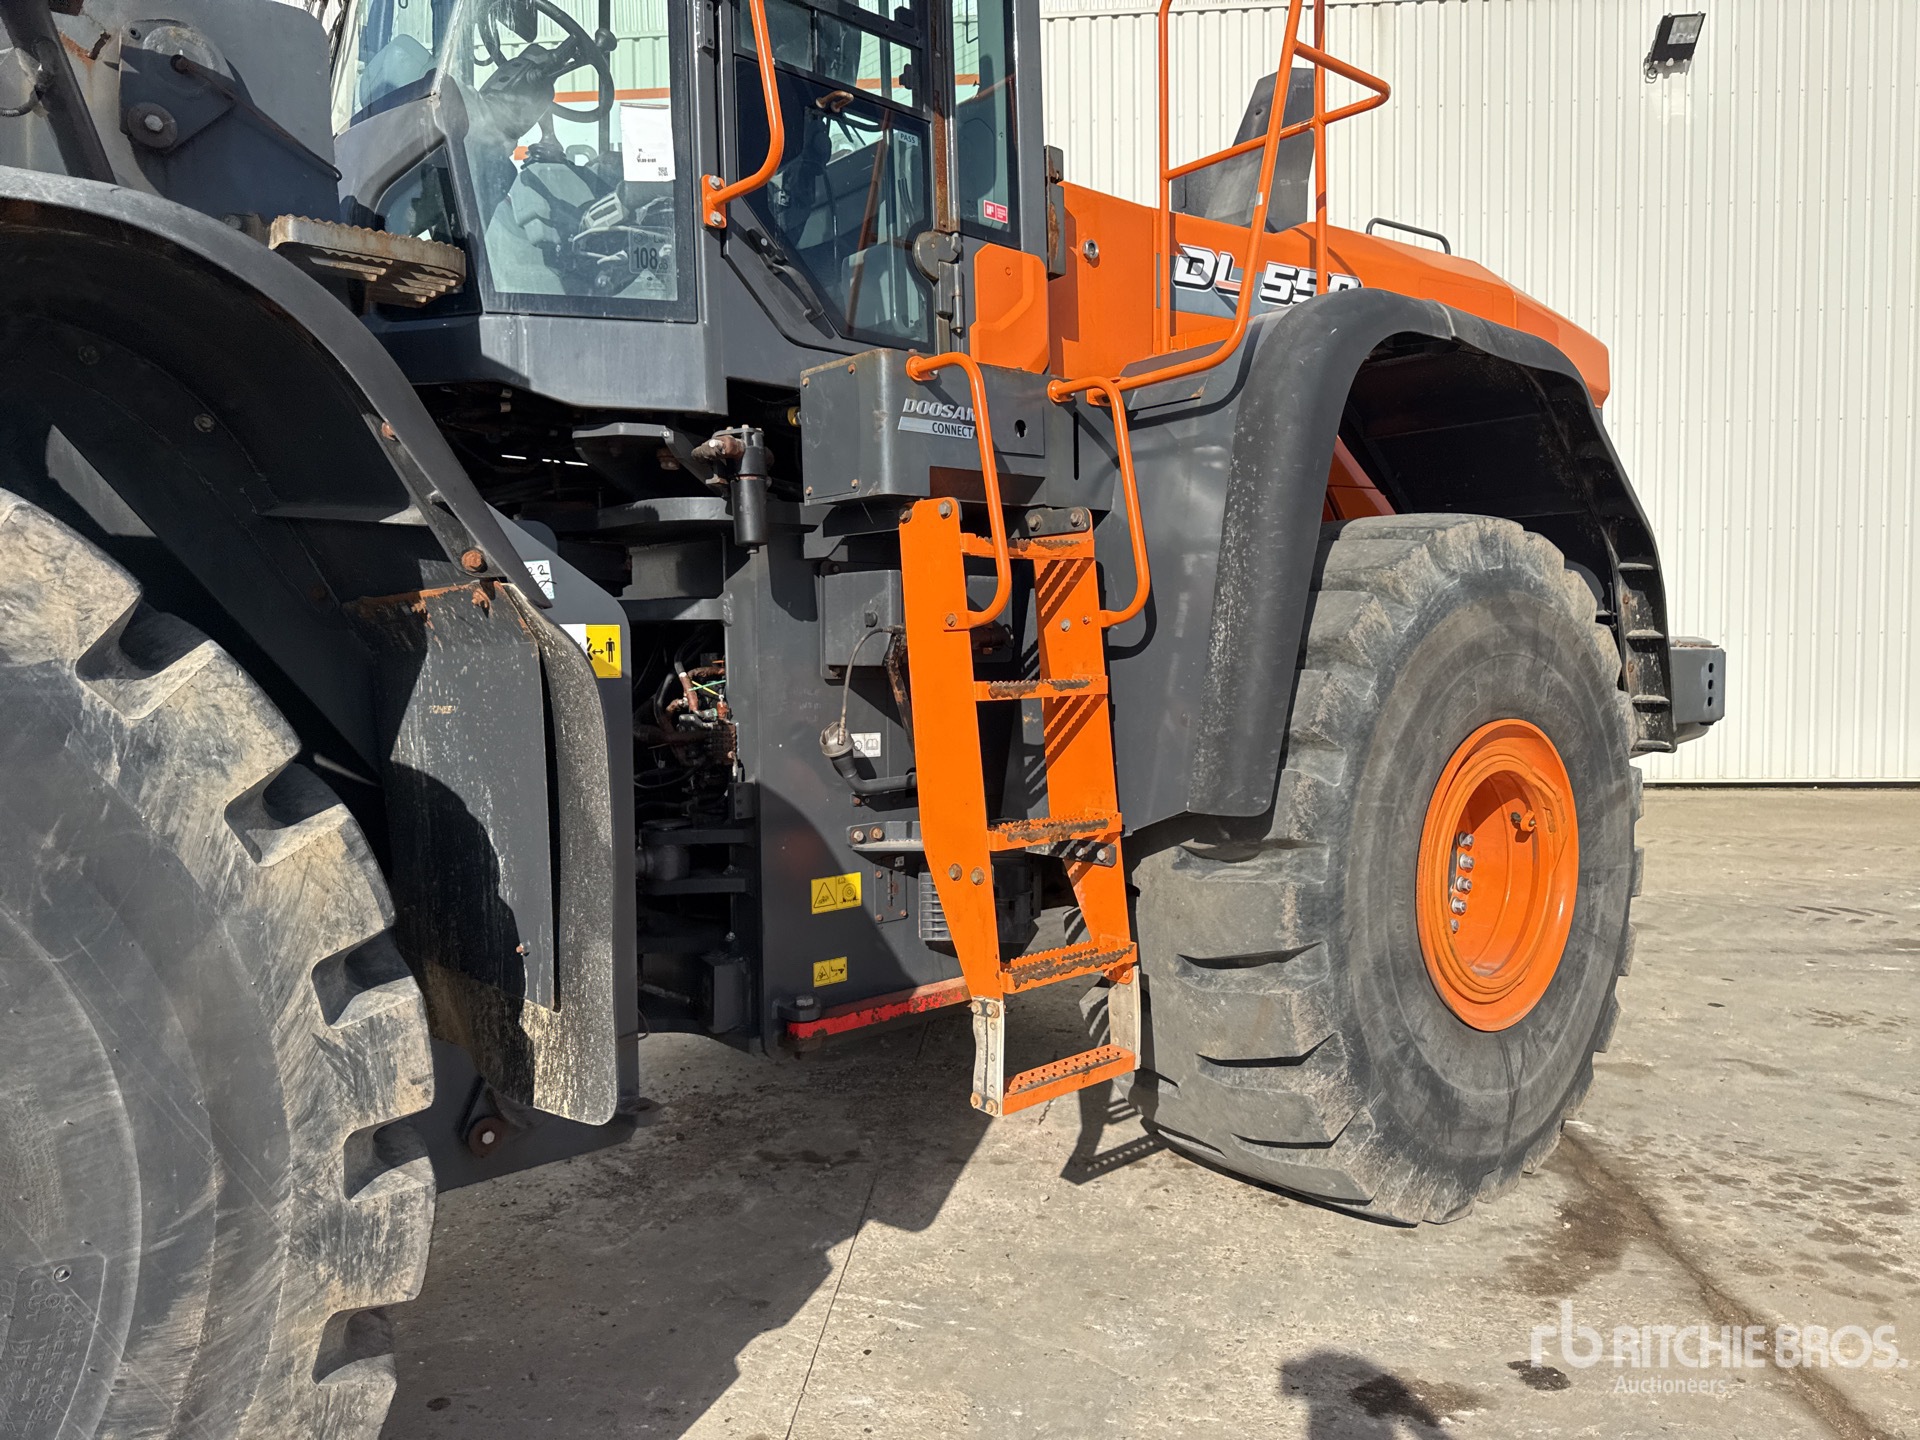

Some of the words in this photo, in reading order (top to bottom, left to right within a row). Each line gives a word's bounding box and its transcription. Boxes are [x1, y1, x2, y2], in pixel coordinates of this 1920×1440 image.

[901, 133, 915, 143] PASS
[633, 247, 658, 270] 108
[1173, 243, 1242, 298] DL
[932, 421, 973, 438] CONNECT
